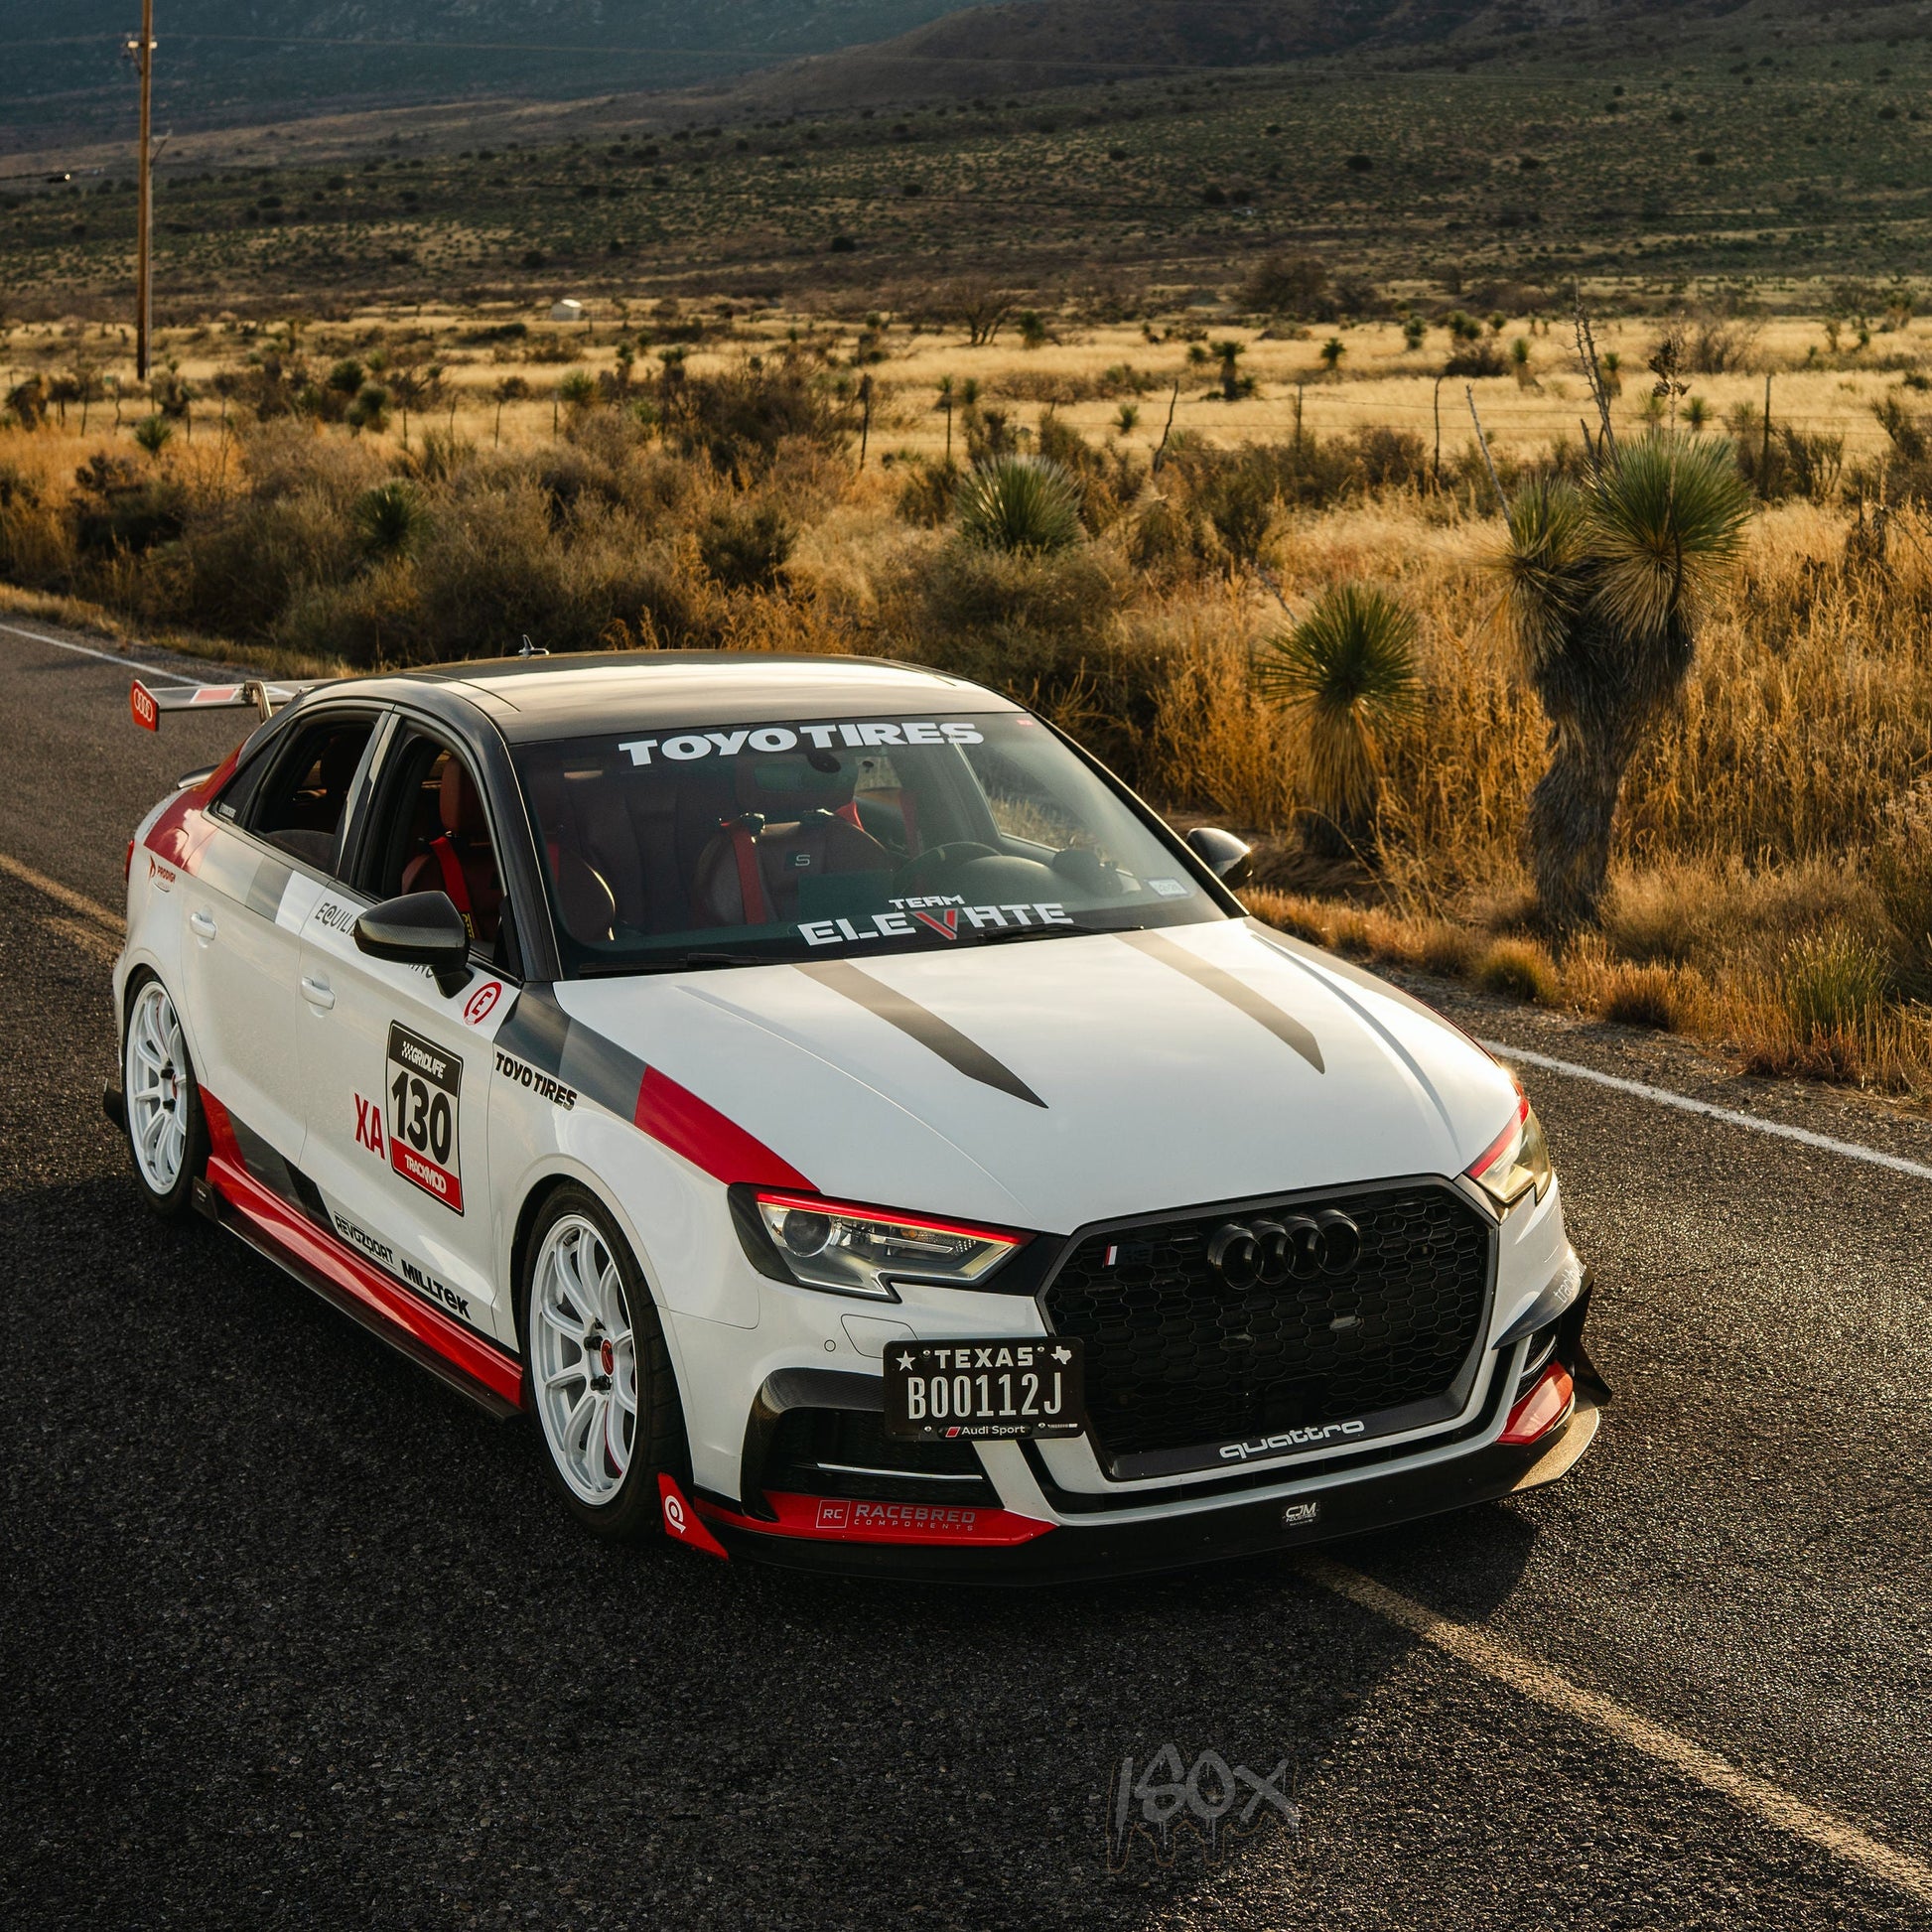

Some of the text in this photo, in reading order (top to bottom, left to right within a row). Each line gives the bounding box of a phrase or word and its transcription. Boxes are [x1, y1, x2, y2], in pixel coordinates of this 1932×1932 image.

[619, 723, 984, 766] TOYO TIRES
[889, 895, 965, 910] TEAM
[797, 903, 1074, 946] ELEVATE
[411, 1046, 447, 1079] GRIDLIFE
[496, 1051, 578, 1111] TOYO TIRES
[353, 1092, 386, 1161] XA
[391, 1070, 452, 1166] 130
[934, 1347, 1034, 1370] TEXAS
[961, 1425, 1026, 1437] Audi Sport
[1219, 1420, 1365, 1458] quattro
[823, 1508, 844, 1519] RC
[854, 1518, 974, 1531] COMPONENTS
[855, 1504, 975, 1524] RACEBRED
